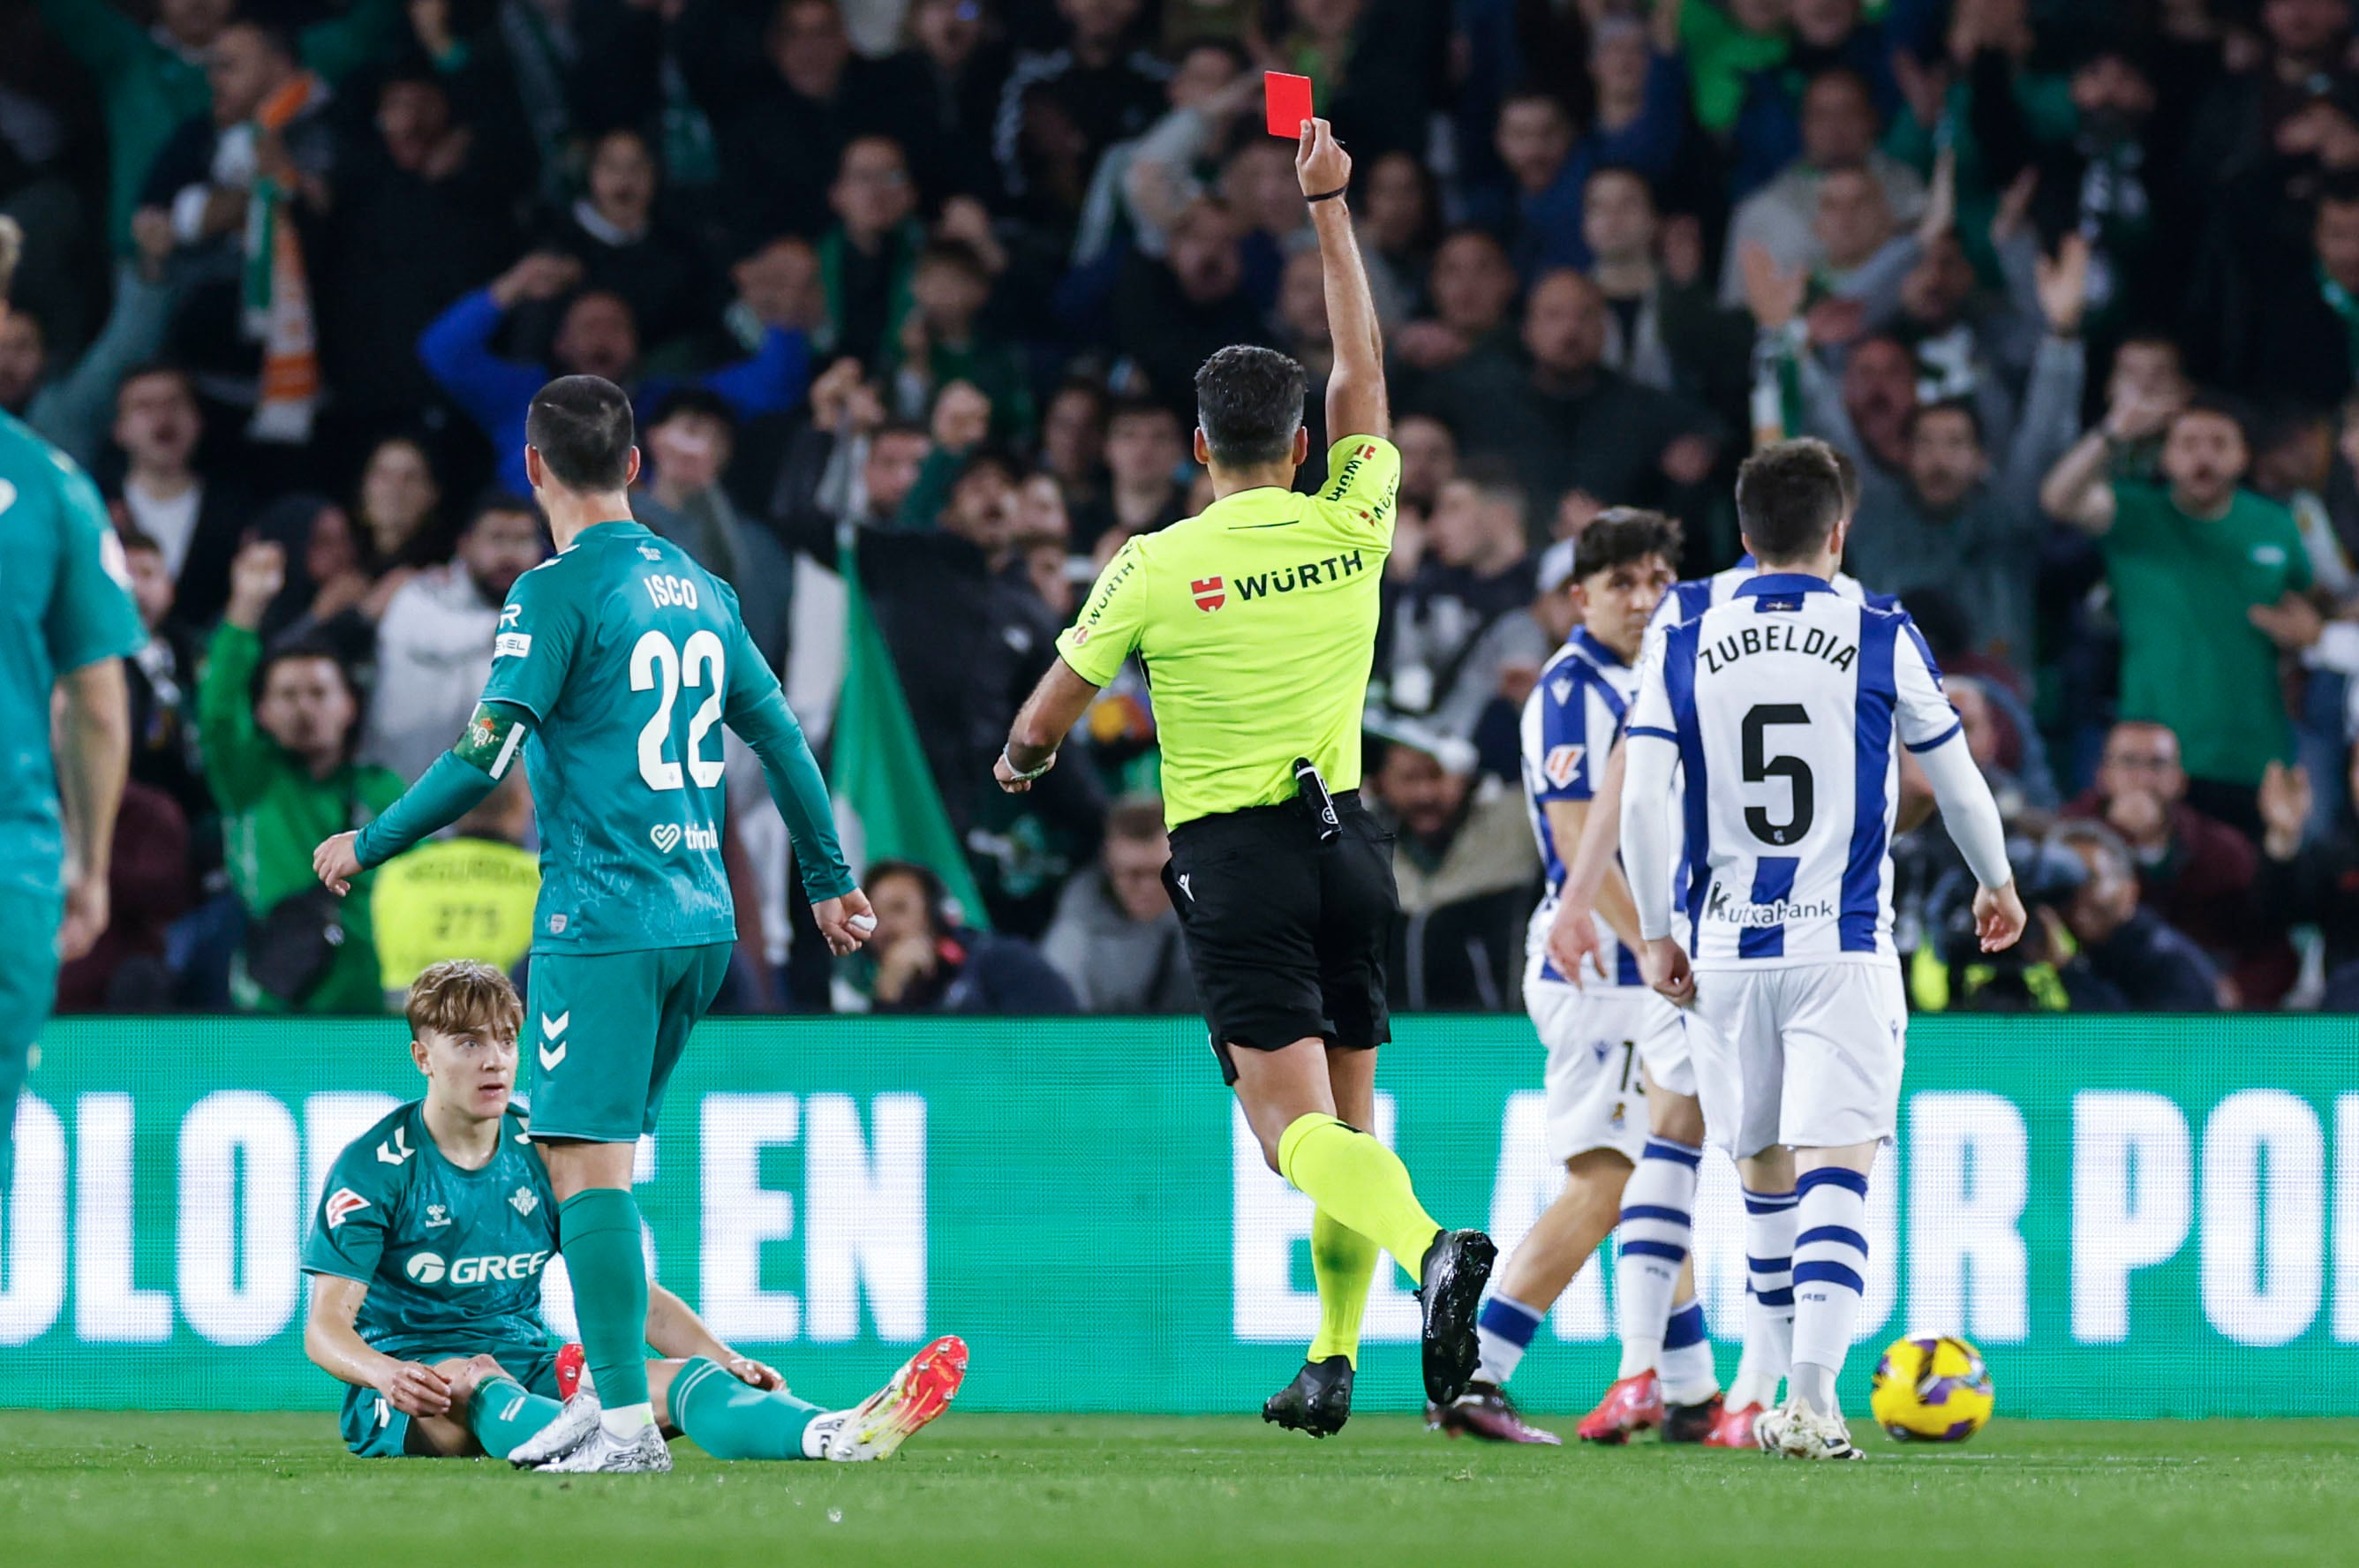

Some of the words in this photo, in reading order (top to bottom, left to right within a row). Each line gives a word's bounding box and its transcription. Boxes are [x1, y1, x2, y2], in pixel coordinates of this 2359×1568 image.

[643, 574, 698, 610] ISCO
[1235, 550, 1364, 601] WÜRTH
[1699, 625, 1858, 674] ZUBELDIA
[629, 629, 725, 791] 22
[1742, 703, 1814, 846] 5
[701, 1091, 928, 1342] EN
[2071, 1088, 2359, 1346] PO
[449, 1249, 549, 1285] GREE
